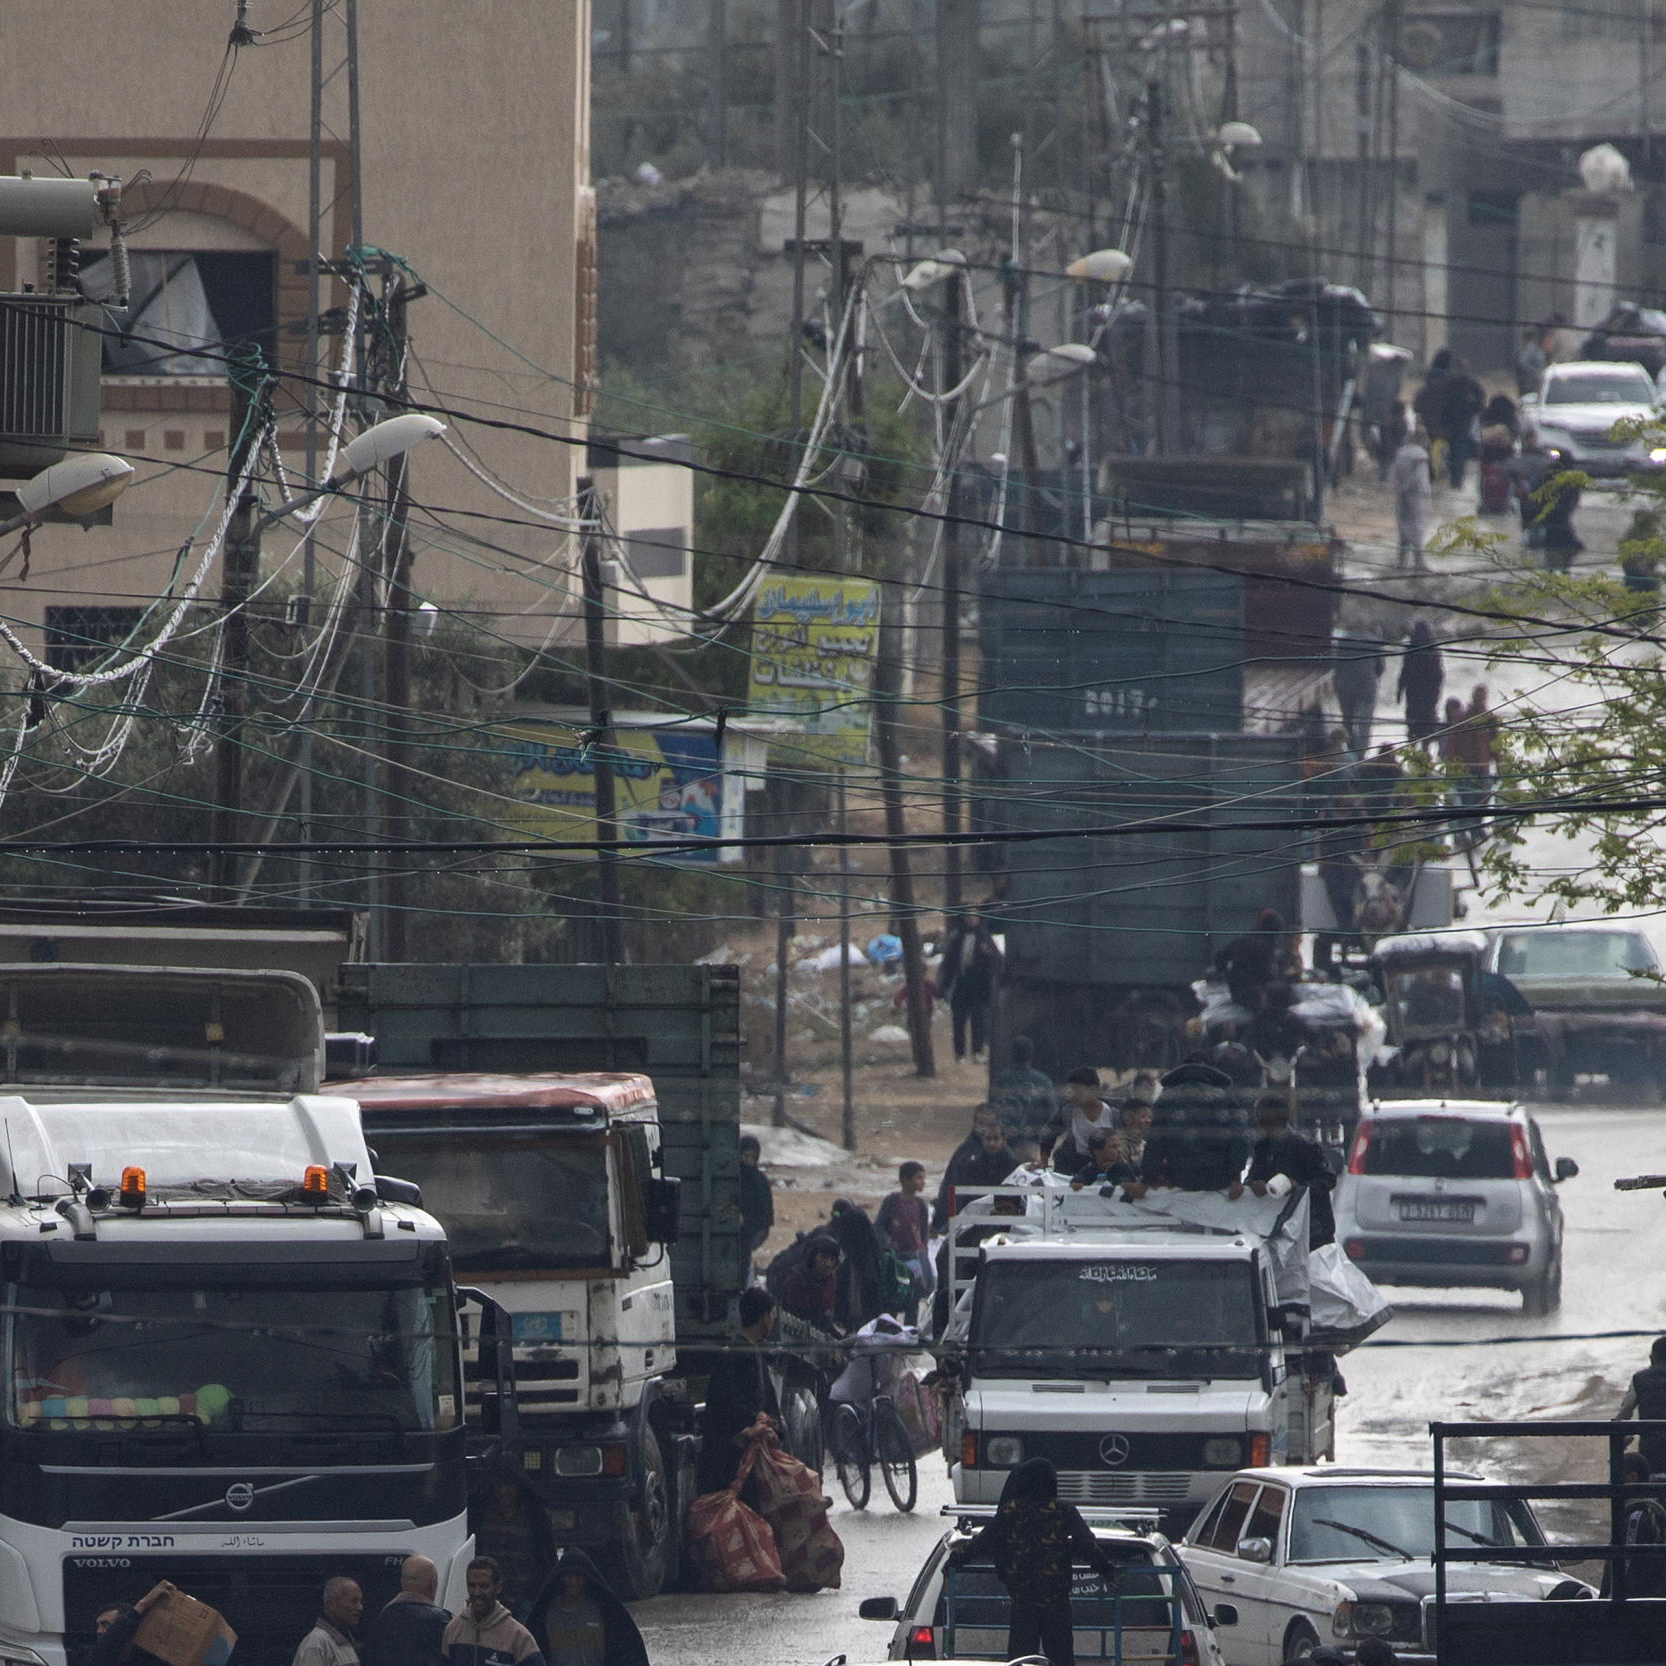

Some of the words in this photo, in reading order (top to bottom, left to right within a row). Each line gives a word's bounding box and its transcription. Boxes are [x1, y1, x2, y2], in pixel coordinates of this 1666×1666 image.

[72, 1536, 123, 1550] קשטה
[127, 1536, 175, 1548] חברת
[74, 1558, 131, 1568] VOLVO
